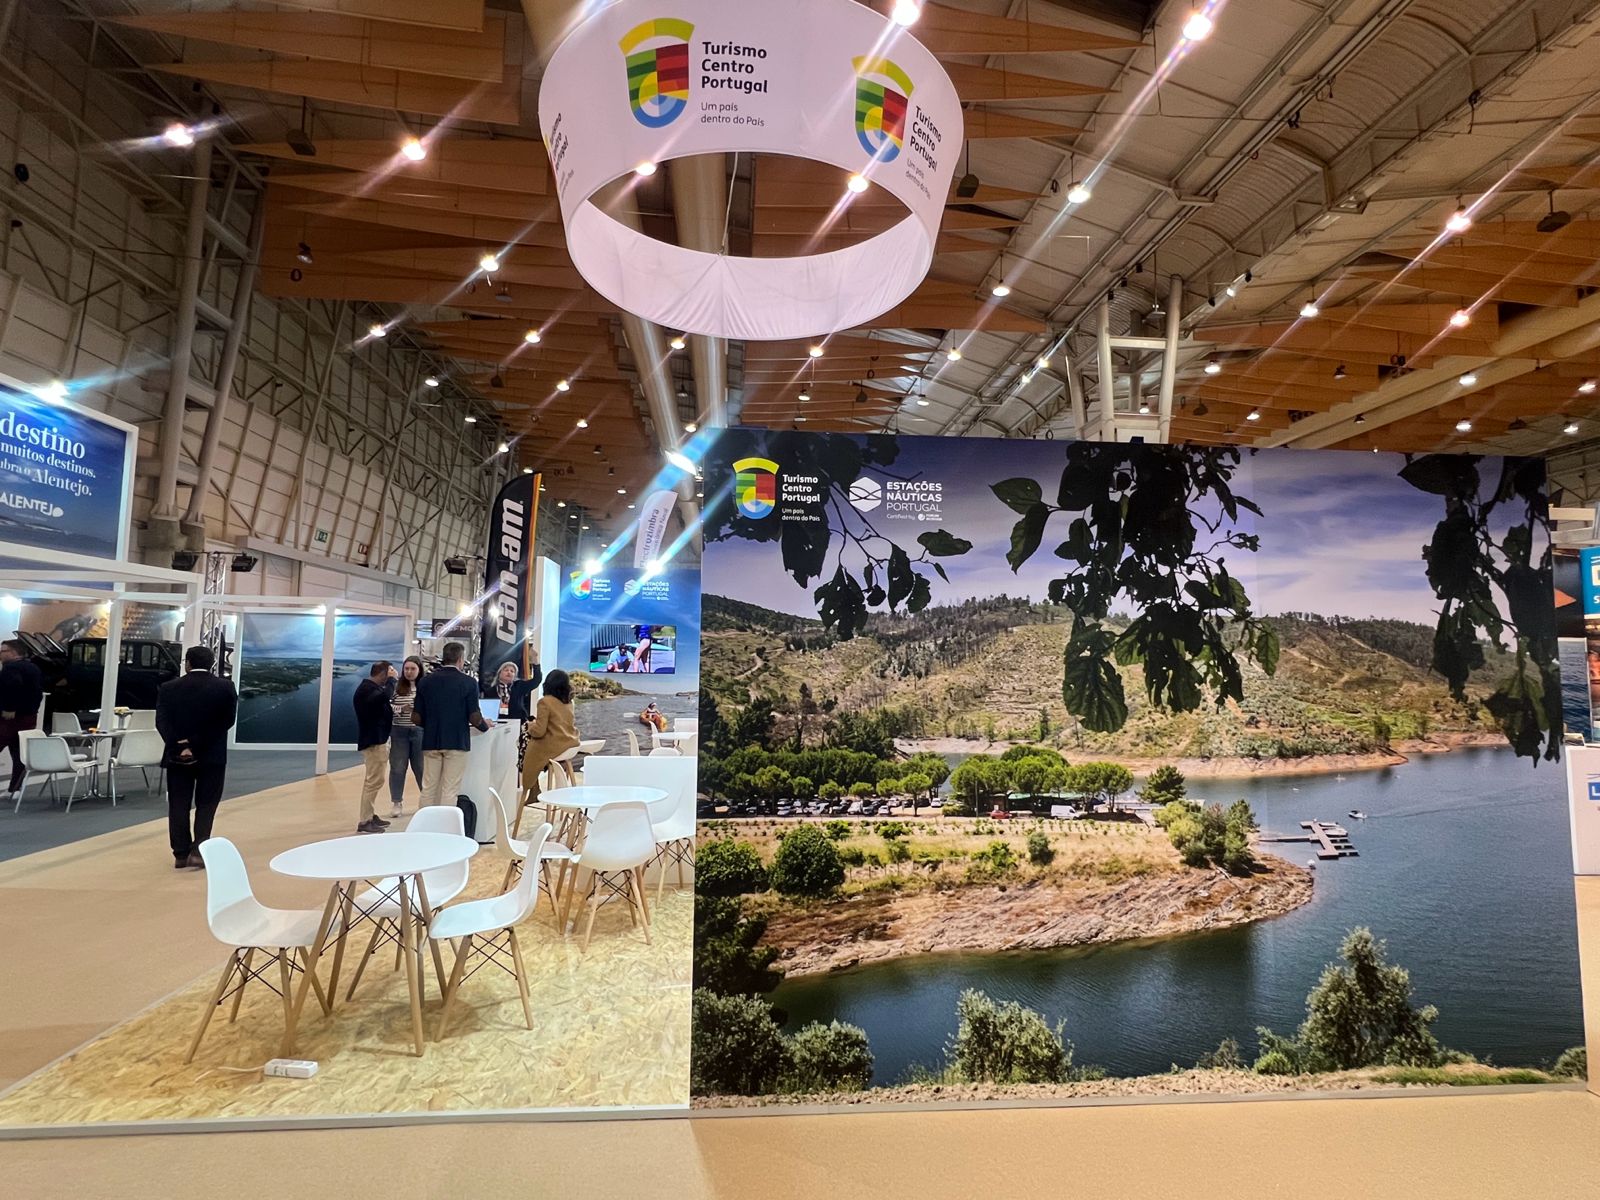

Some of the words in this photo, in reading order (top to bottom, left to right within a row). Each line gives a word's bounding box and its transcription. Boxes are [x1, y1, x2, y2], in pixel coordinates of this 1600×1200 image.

[702, 41, 767, 59] Turismo
[702, 58, 754, 74] Centro
[701, 75, 768, 95] Portugal
[701, 102, 717, 111] Um
[701, 114, 731, 124] dentro
[733, 115, 745, 125] do
[916, 105, 942, 143] Turismo
[912, 121, 936, 152] Centro
[905, 135, 938, 173] Portugal
[0, 411, 86, 459] destino
[0, 442, 45, 463] muitos
[46, 453, 96, 479] destinos.
[32, 468, 92, 496] Alentejo.
[782, 474, 819, 484] Turismo
[886, 480, 943, 492] ESTAÇÕES
[782, 483, 812, 492] Centro
[782, 493, 820, 504] Portugal
[886, 490, 943, 502] NÁUTICAS
[886, 502, 943, 512] PORTUGAL
